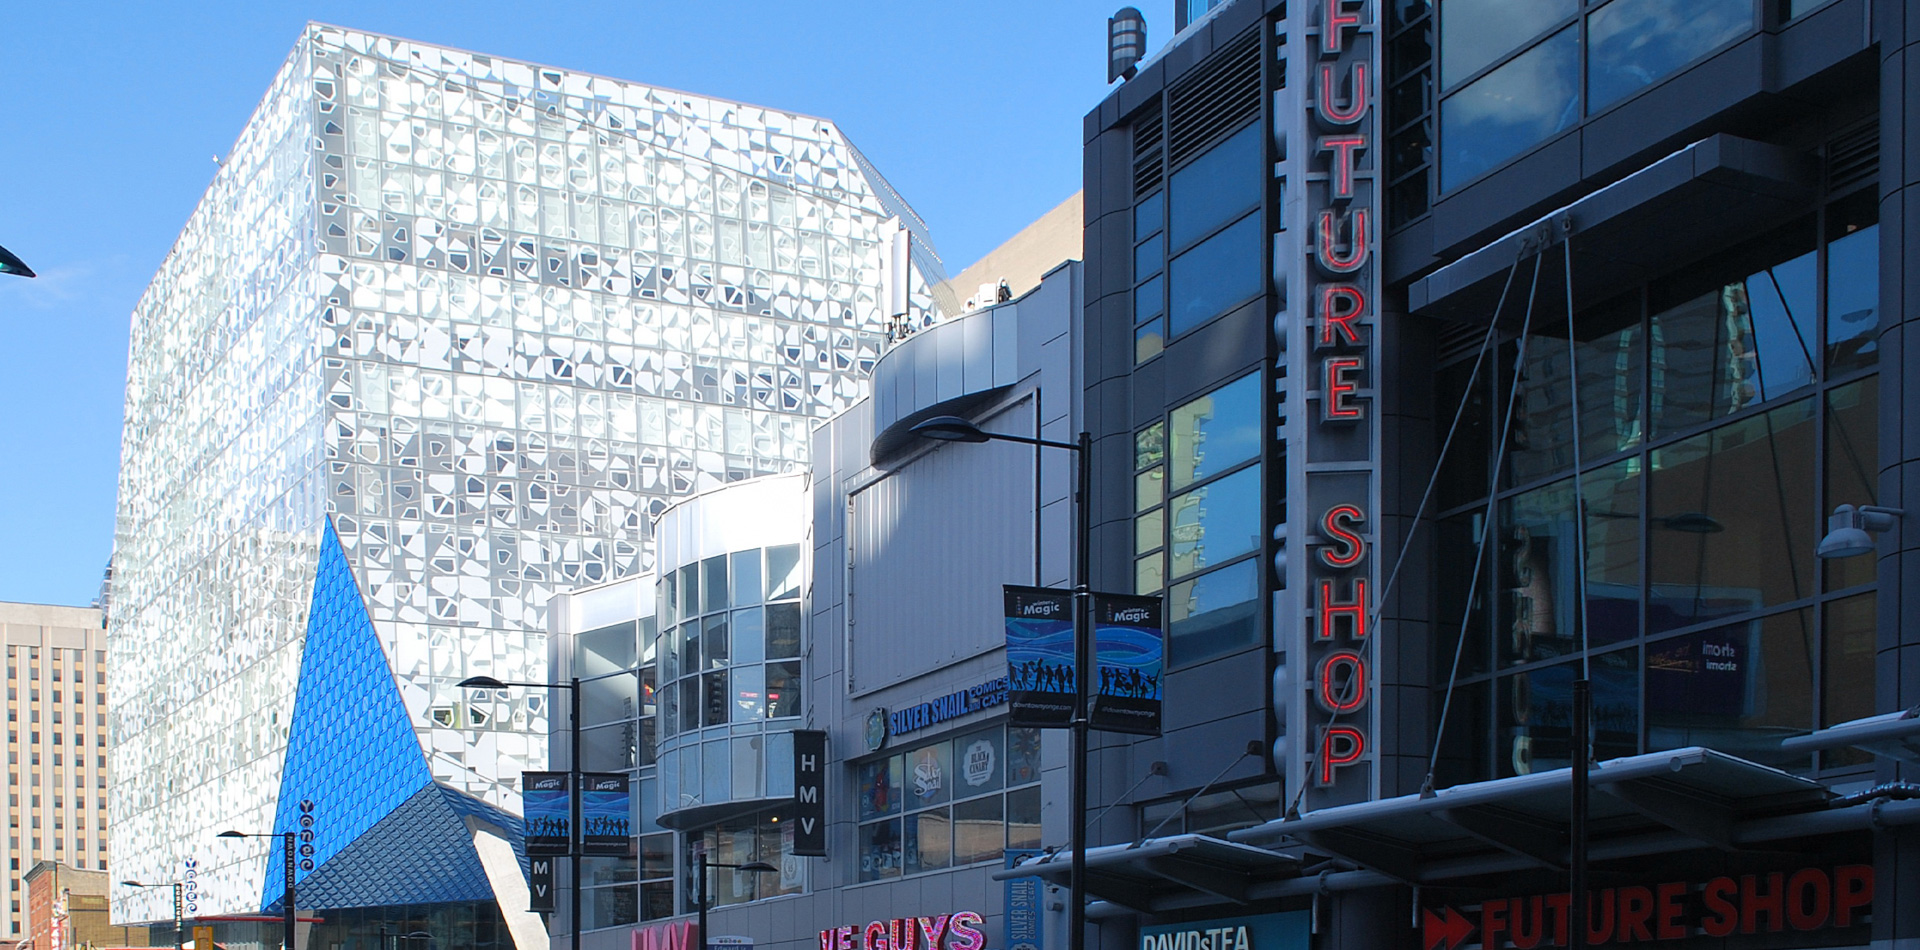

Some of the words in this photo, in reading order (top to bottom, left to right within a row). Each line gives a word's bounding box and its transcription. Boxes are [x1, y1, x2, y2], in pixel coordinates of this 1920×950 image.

[1315, 0, 1371, 425] FUTURE
[1023, 602, 1060, 616] Magic
[1114, 609, 1150, 623] Magic
[1313, 504, 1366, 788] SHOP
[968, 676, 1010, 699] COMICS
[982, 690, 1010, 709] CAFE
[890, 703, 931, 736] SILVER
[931, 690, 968, 724] SNAIL
[800, 754, 817, 835] HMV
[286, 835, 294, 889] DOWNTOWN
[1011, 880, 1028, 907] SNAIL
[1482, 881, 1688, 950] FUTURE
[1702, 865, 1875, 937] SHOP
[863, 911, 984, 950] GUYS
[1011, 909, 1028, 940] SILVER
[1028, 911, 1036, 940] COMICS
